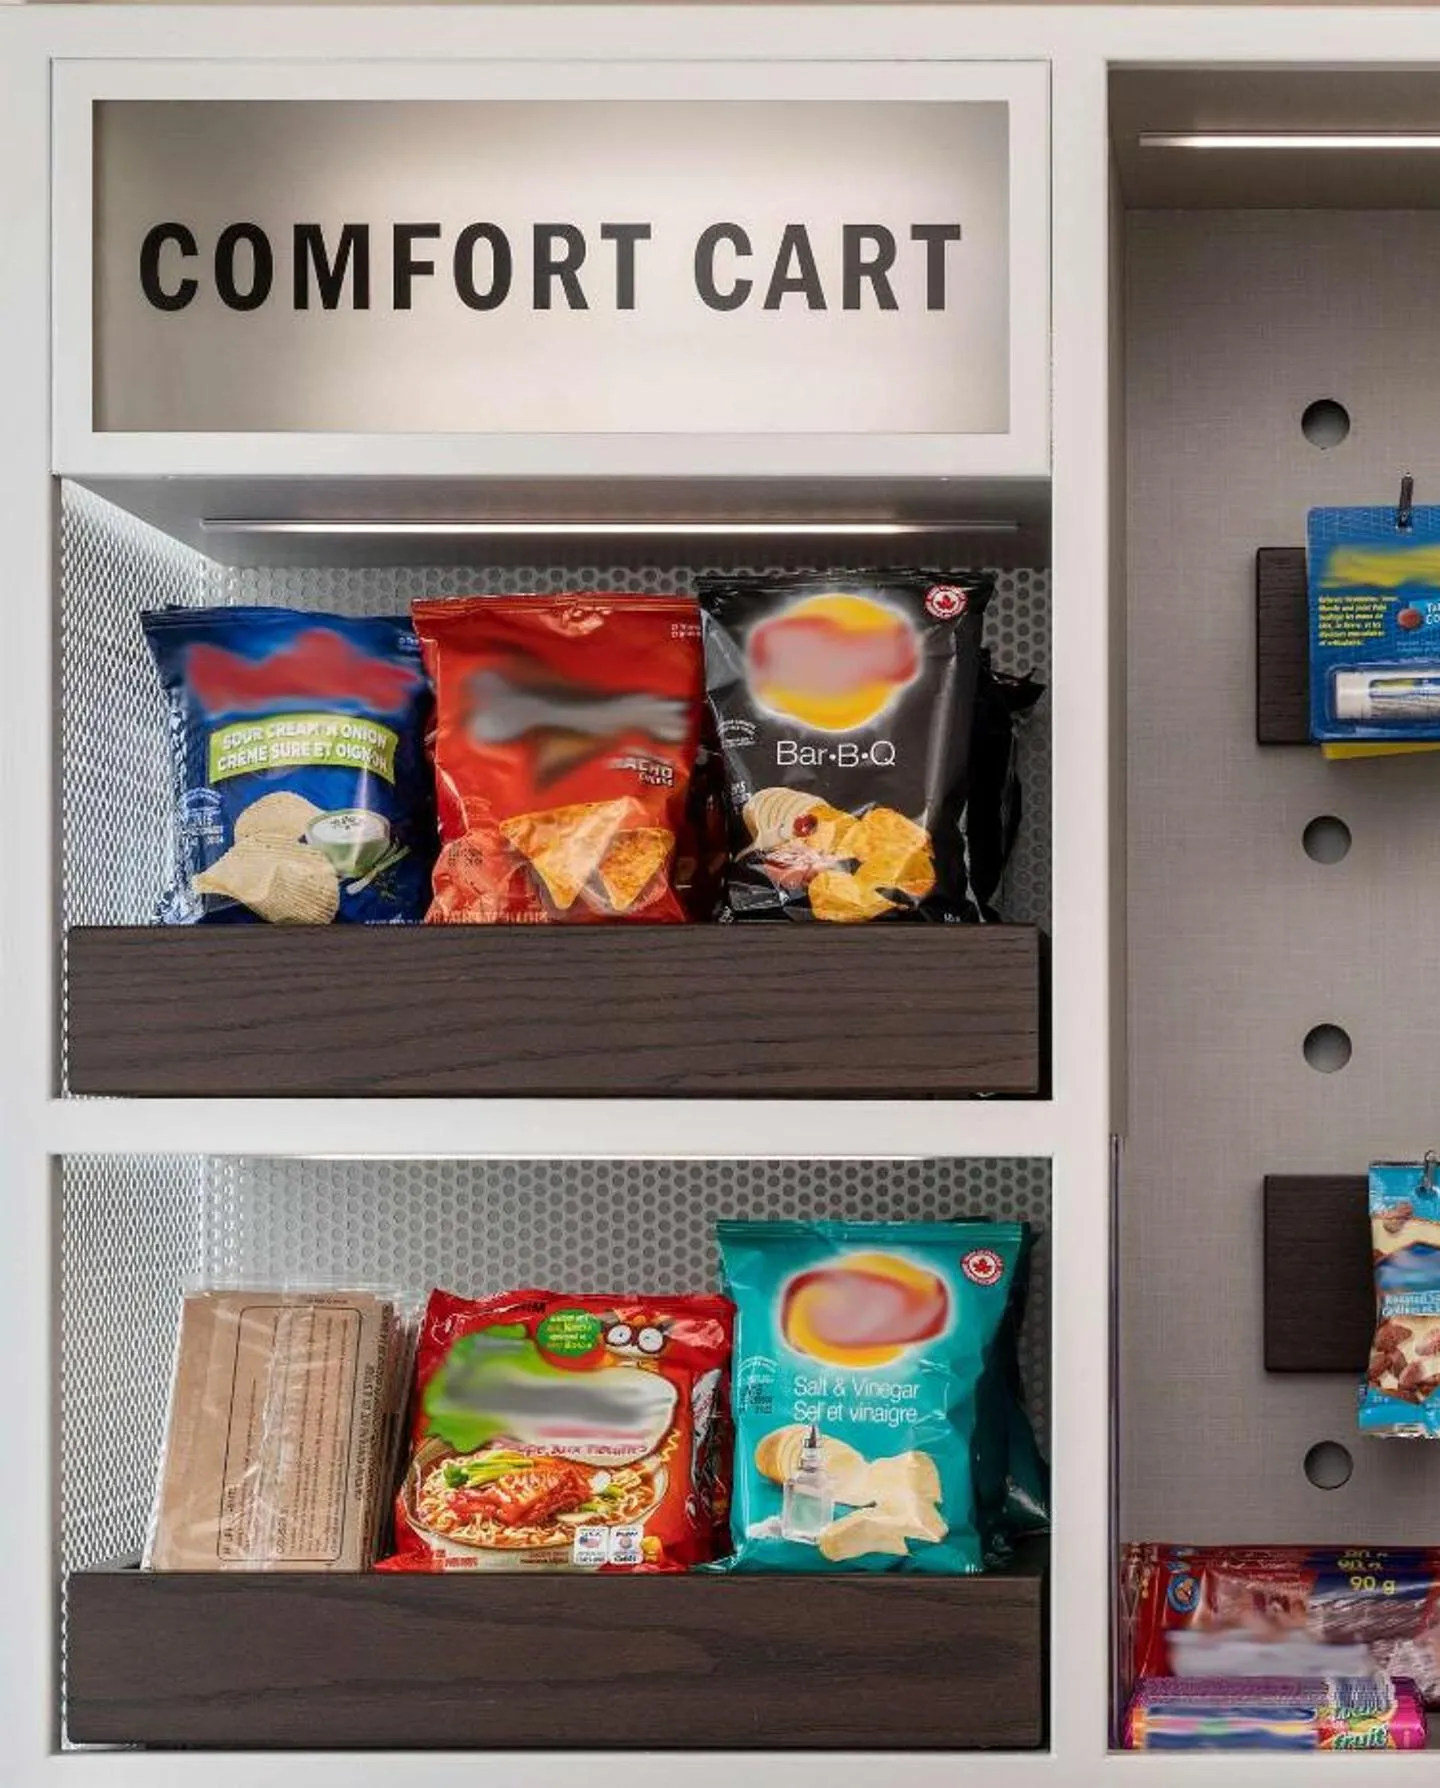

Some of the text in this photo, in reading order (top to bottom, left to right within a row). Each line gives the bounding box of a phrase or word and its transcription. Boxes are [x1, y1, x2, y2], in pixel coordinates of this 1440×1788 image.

[139, 222, 962, 312] COMFORT CART
[223, 727, 264, 750] SOUR
[341, 723, 388, 750] ONION
[271, 742, 312, 760] SURE
[315, 742, 333, 758] ET
[794, 1375, 921, 1403] Salt & Vinegar
[793, 1400, 919, 1428] Sel et vinaigre
[1350, 1575, 1396, 1596] 90 g
